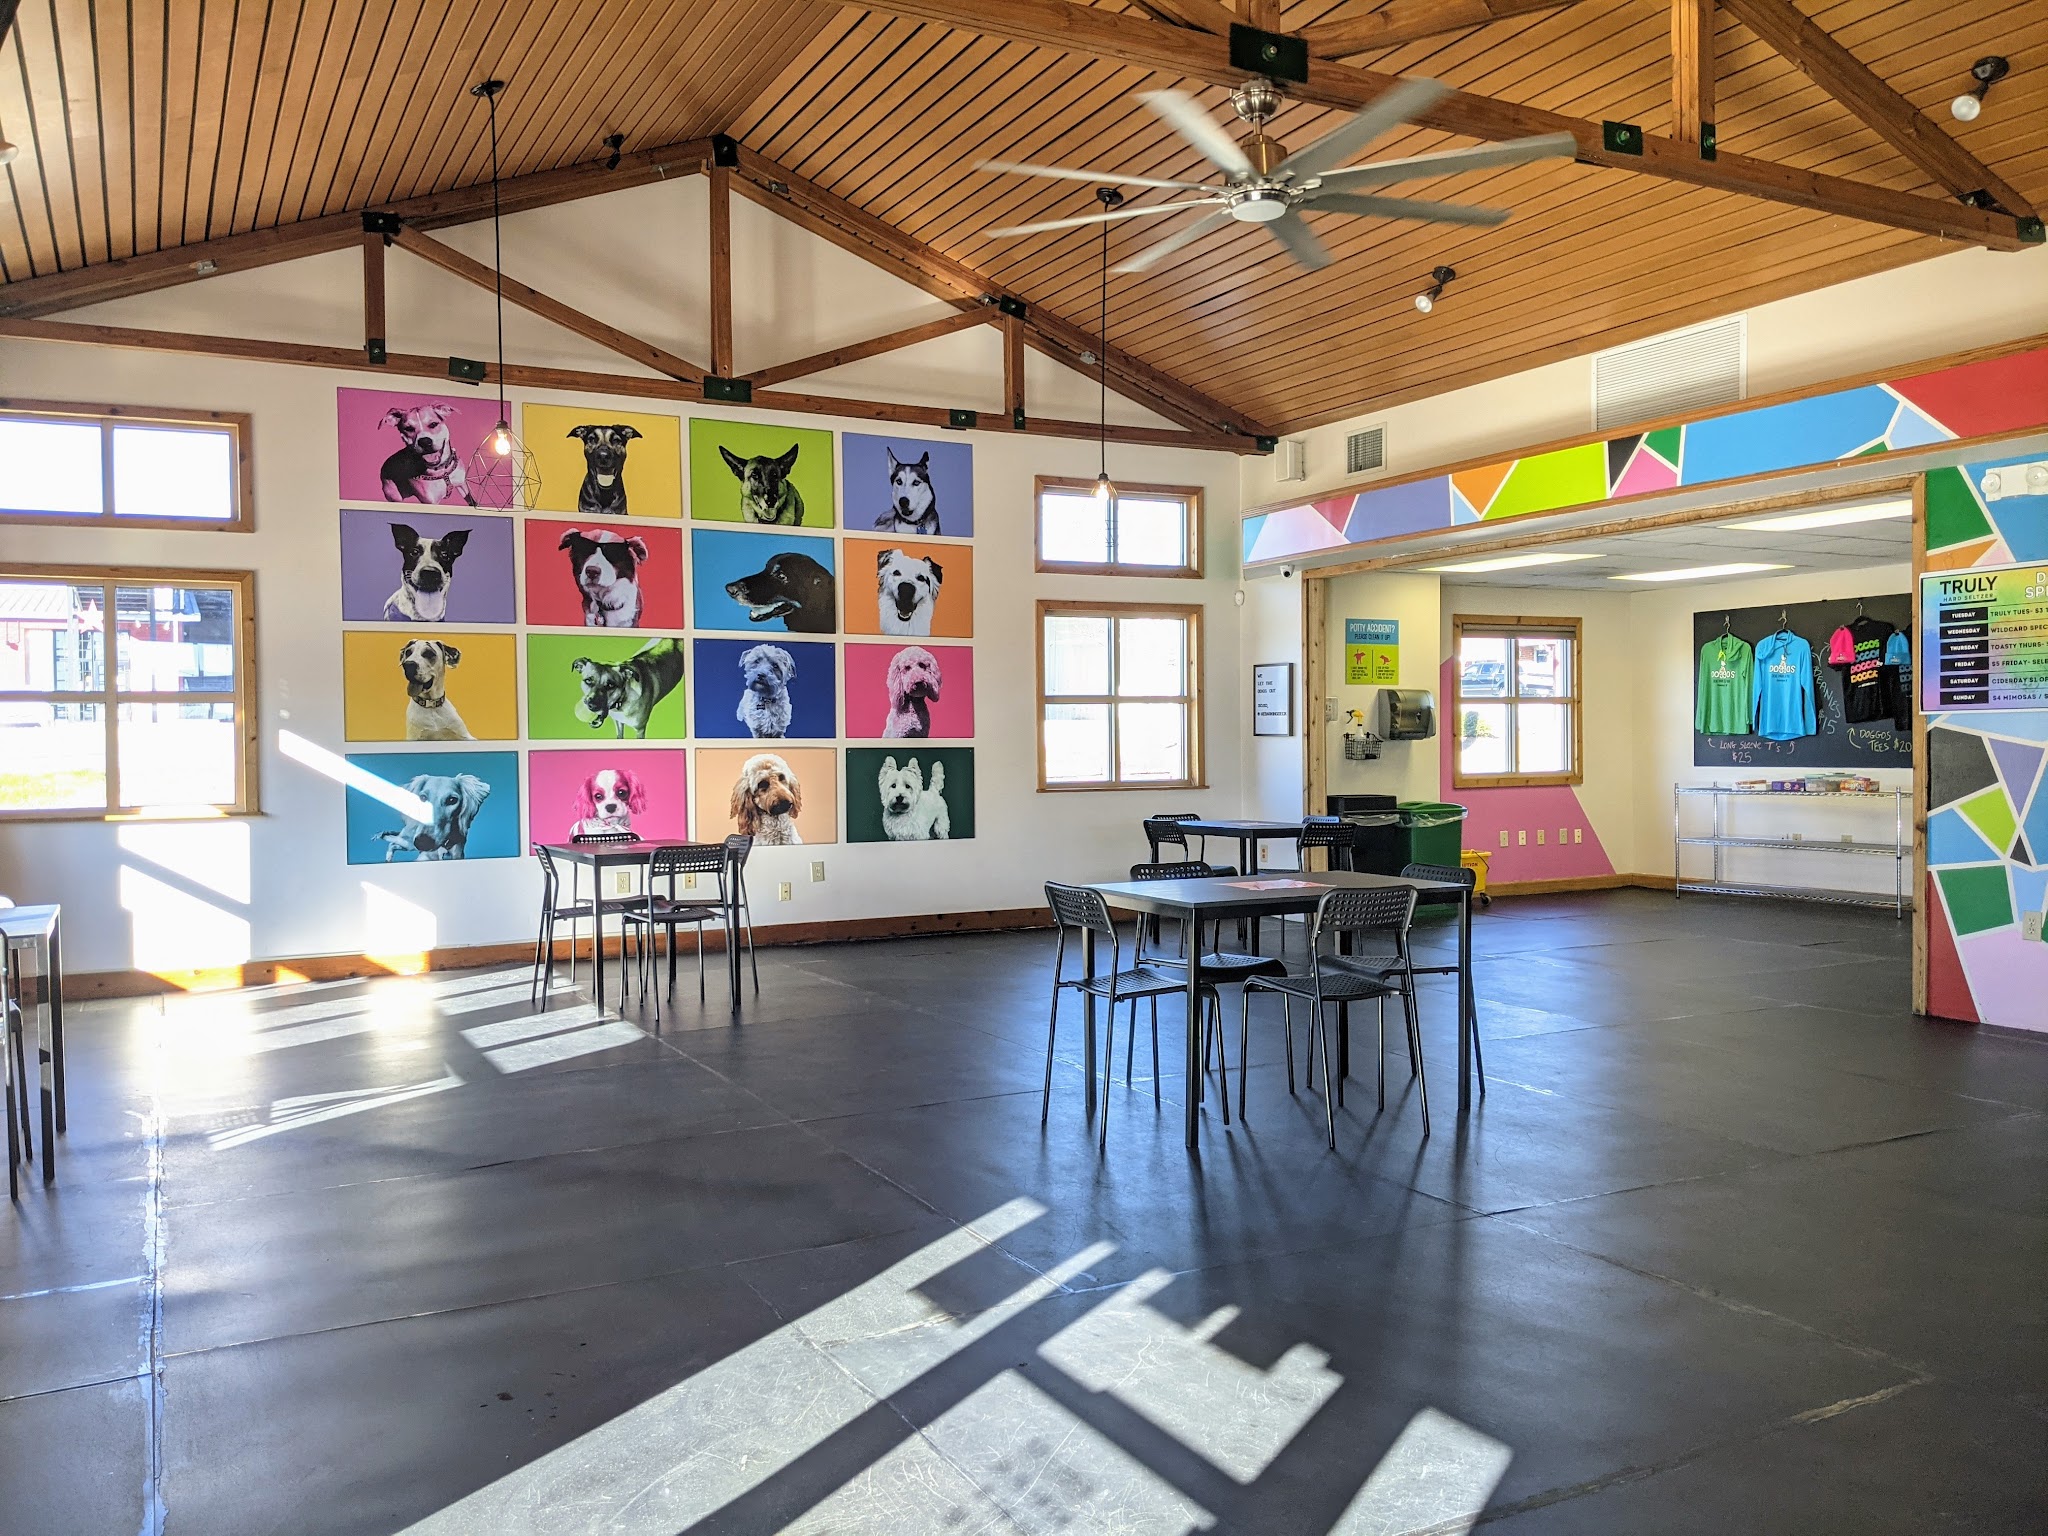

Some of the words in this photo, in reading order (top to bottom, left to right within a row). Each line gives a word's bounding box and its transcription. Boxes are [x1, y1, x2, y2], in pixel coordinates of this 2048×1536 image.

[1940, 576, 1998, 595] TRULY
[1964, 593, 1994, 601] SELTZER
[1951, 611, 1976, 619] TUESDAY
[1990, 609, 2012, 617] TRULY
[1350, 623, 1366, 632] POTTY
[1367, 623, 1396, 633] ACCIDENT?
[1947, 627, 1980, 635] WEDNESDAY
[1990, 625, 2028, 633] WILDCARD
[1818, 709, 1838, 735] $15
[1860, 729, 1891, 741] DOGGOS
[1720, 740, 1737, 749] LONG
[1739, 740, 1762, 750] SLEEVE
[1868, 739, 1890, 752] TEES
[1893, 737, 1912, 753] $20
[1732, 751, 1752, 764] $25
